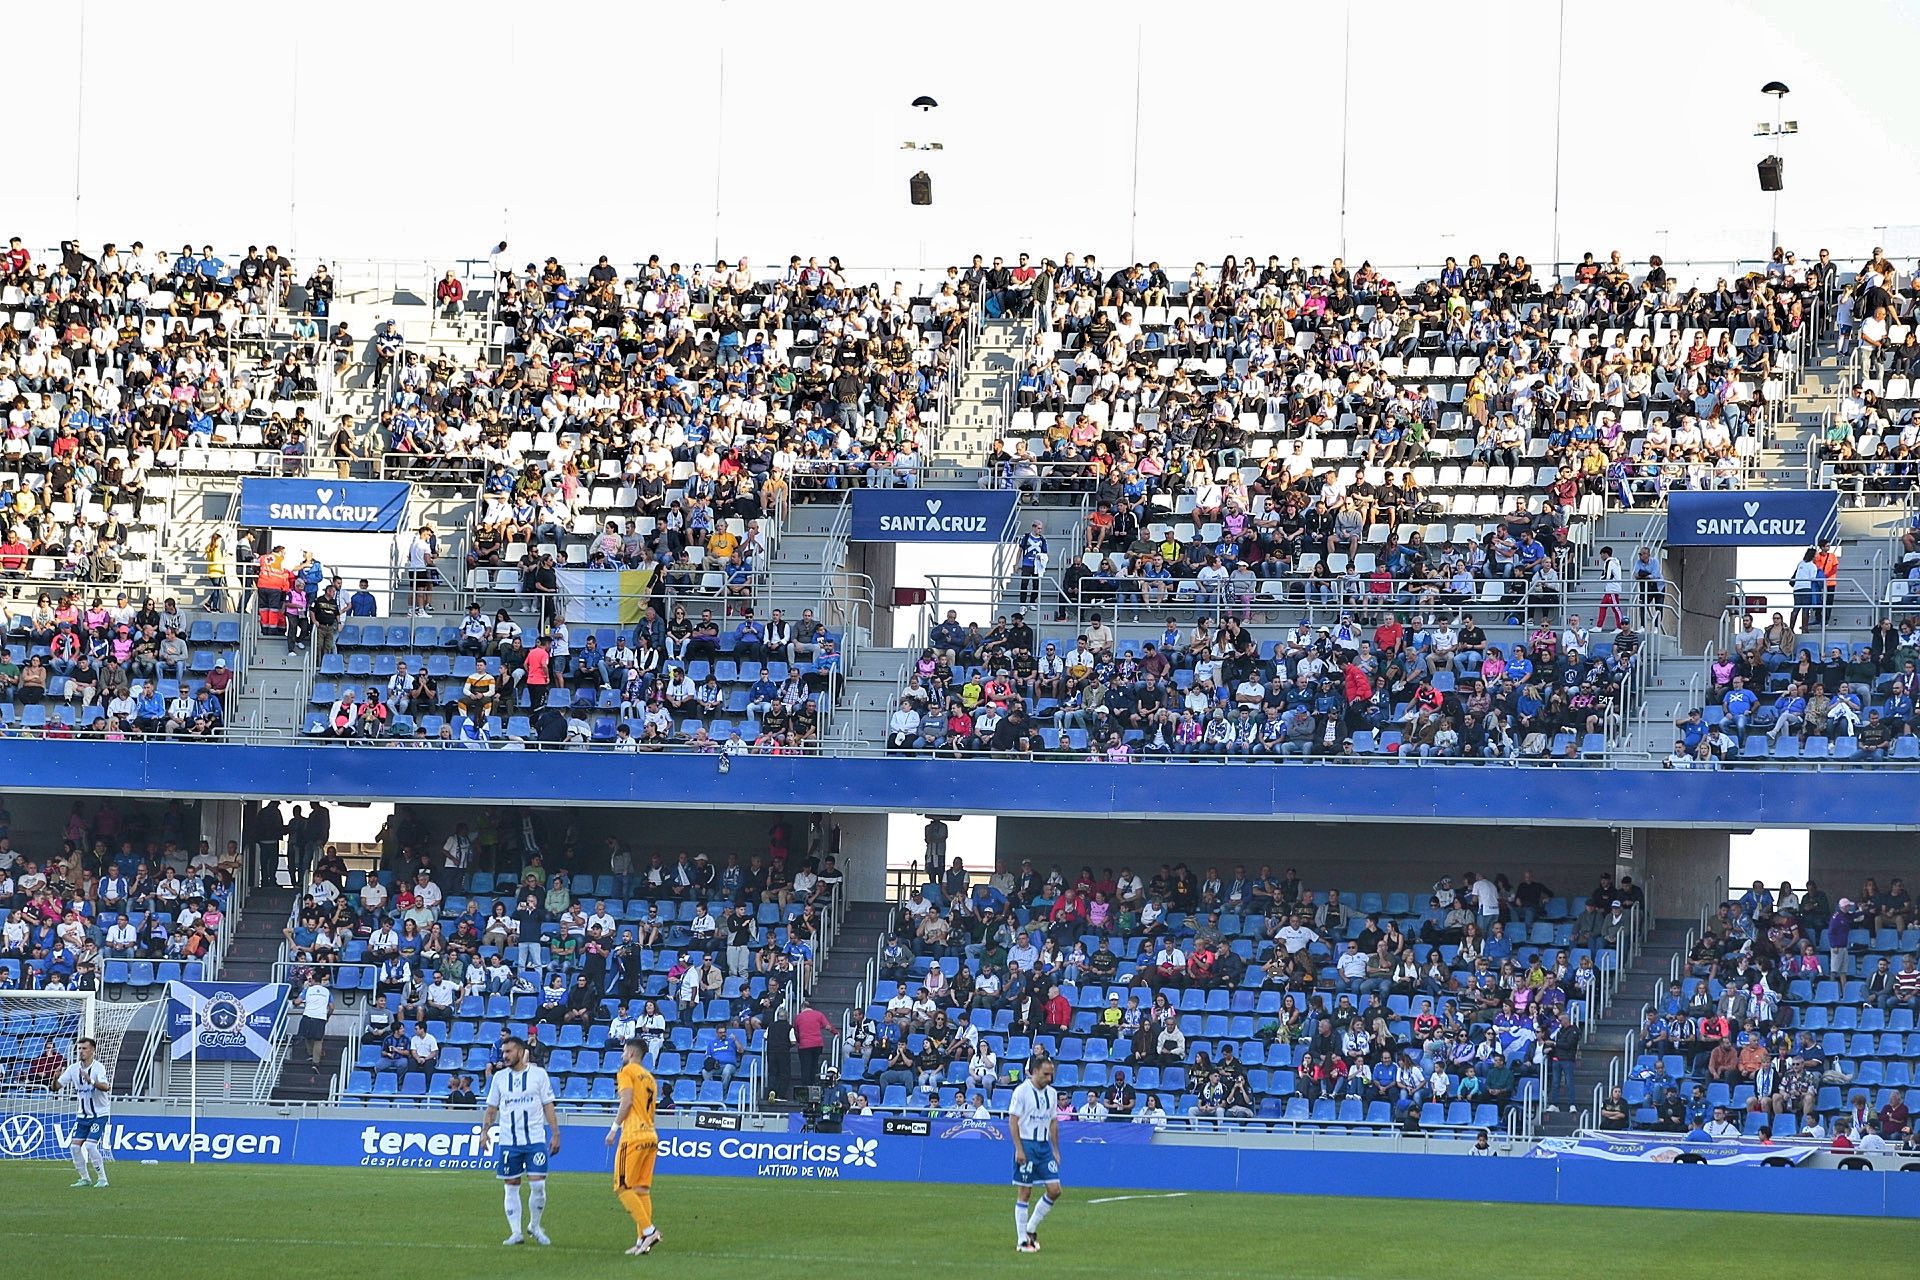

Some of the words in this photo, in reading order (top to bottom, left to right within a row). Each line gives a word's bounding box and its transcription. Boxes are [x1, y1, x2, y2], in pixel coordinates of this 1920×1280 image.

[54, 1122, 280, 1159] Vlkswagen
[656, 1136, 712, 1158] slas
[719, 1138, 840, 1162] Canarias
[361, 1155, 432, 1168] despierta
[758, 1164, 798, 1176] LATITUD
[802, 1166, 813, 1176] DE
[817, 1166, 839, 1178] VIDA
